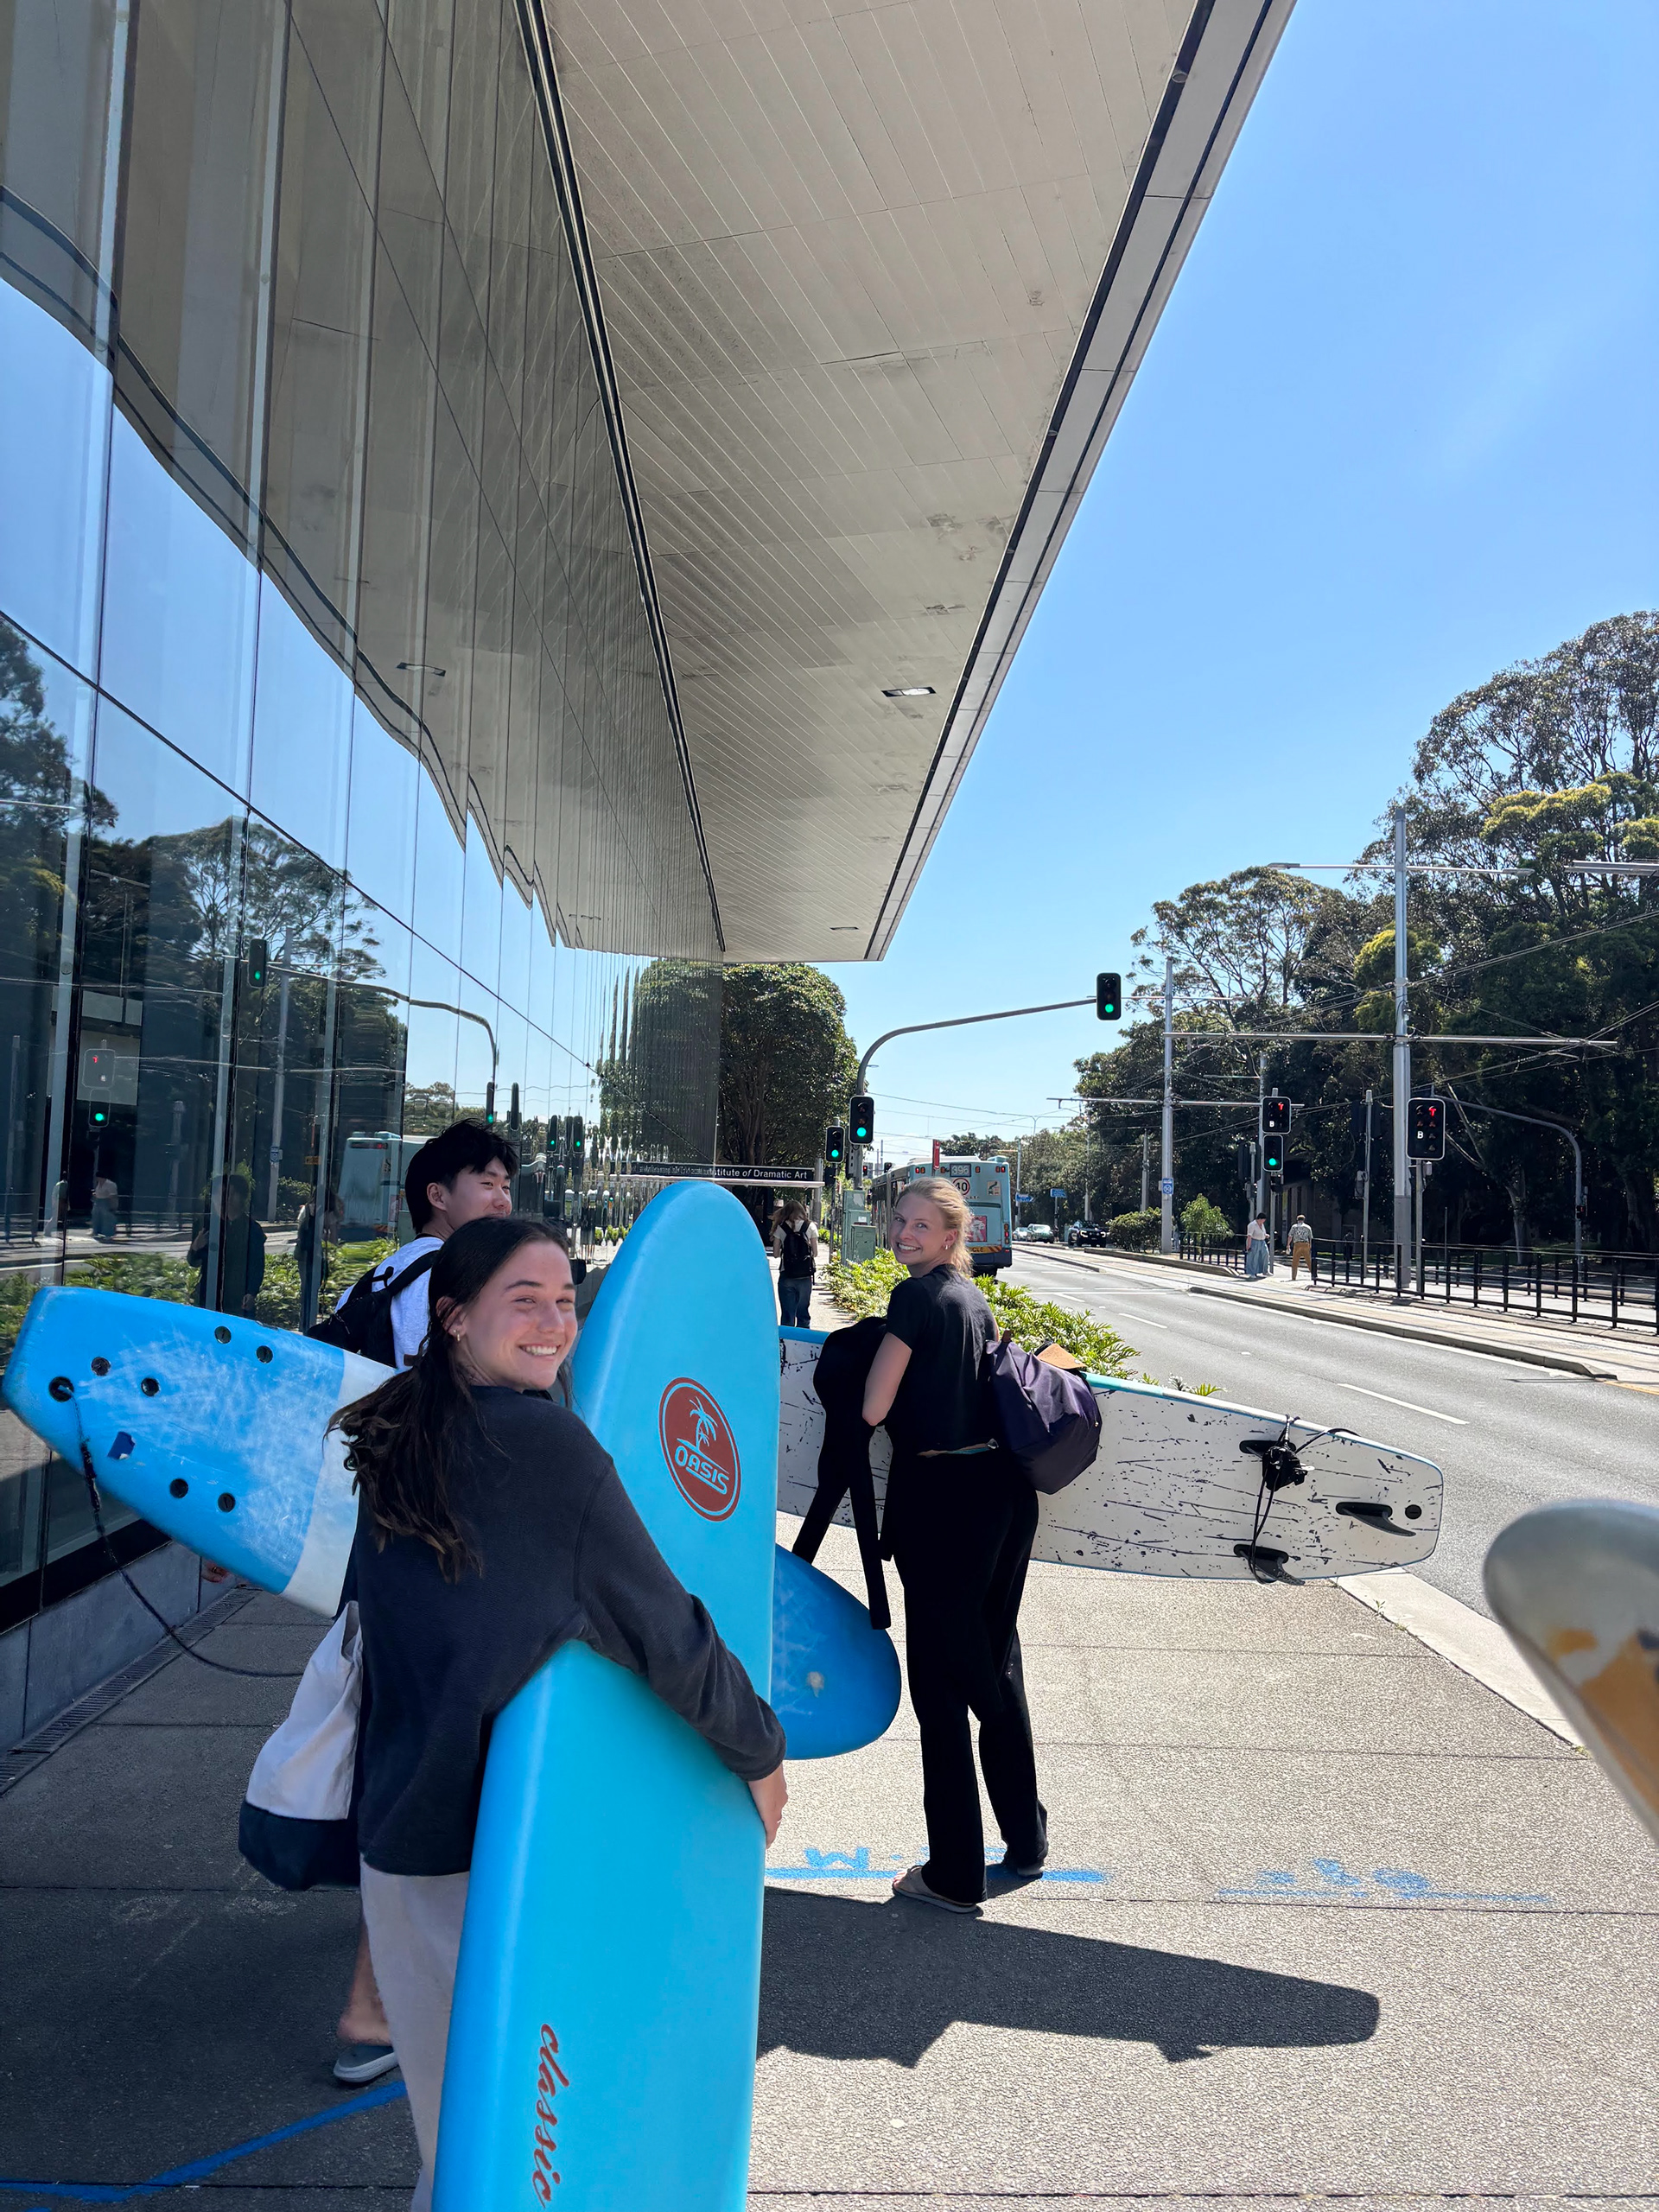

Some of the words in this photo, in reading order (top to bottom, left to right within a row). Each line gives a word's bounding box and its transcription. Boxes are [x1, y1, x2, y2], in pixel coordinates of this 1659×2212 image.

[1417, 1130, 1424, 1139] B
[742, 1168, 752, 1177] of
[753, 1169, 791, 1179] Dramatic
[794, 1170, 807, 1179] Art
[955, 1182, 968, 1191] 40
[674, 1445, 730, 1495] OASIS
[531, 2023, 570, 2209] classic
